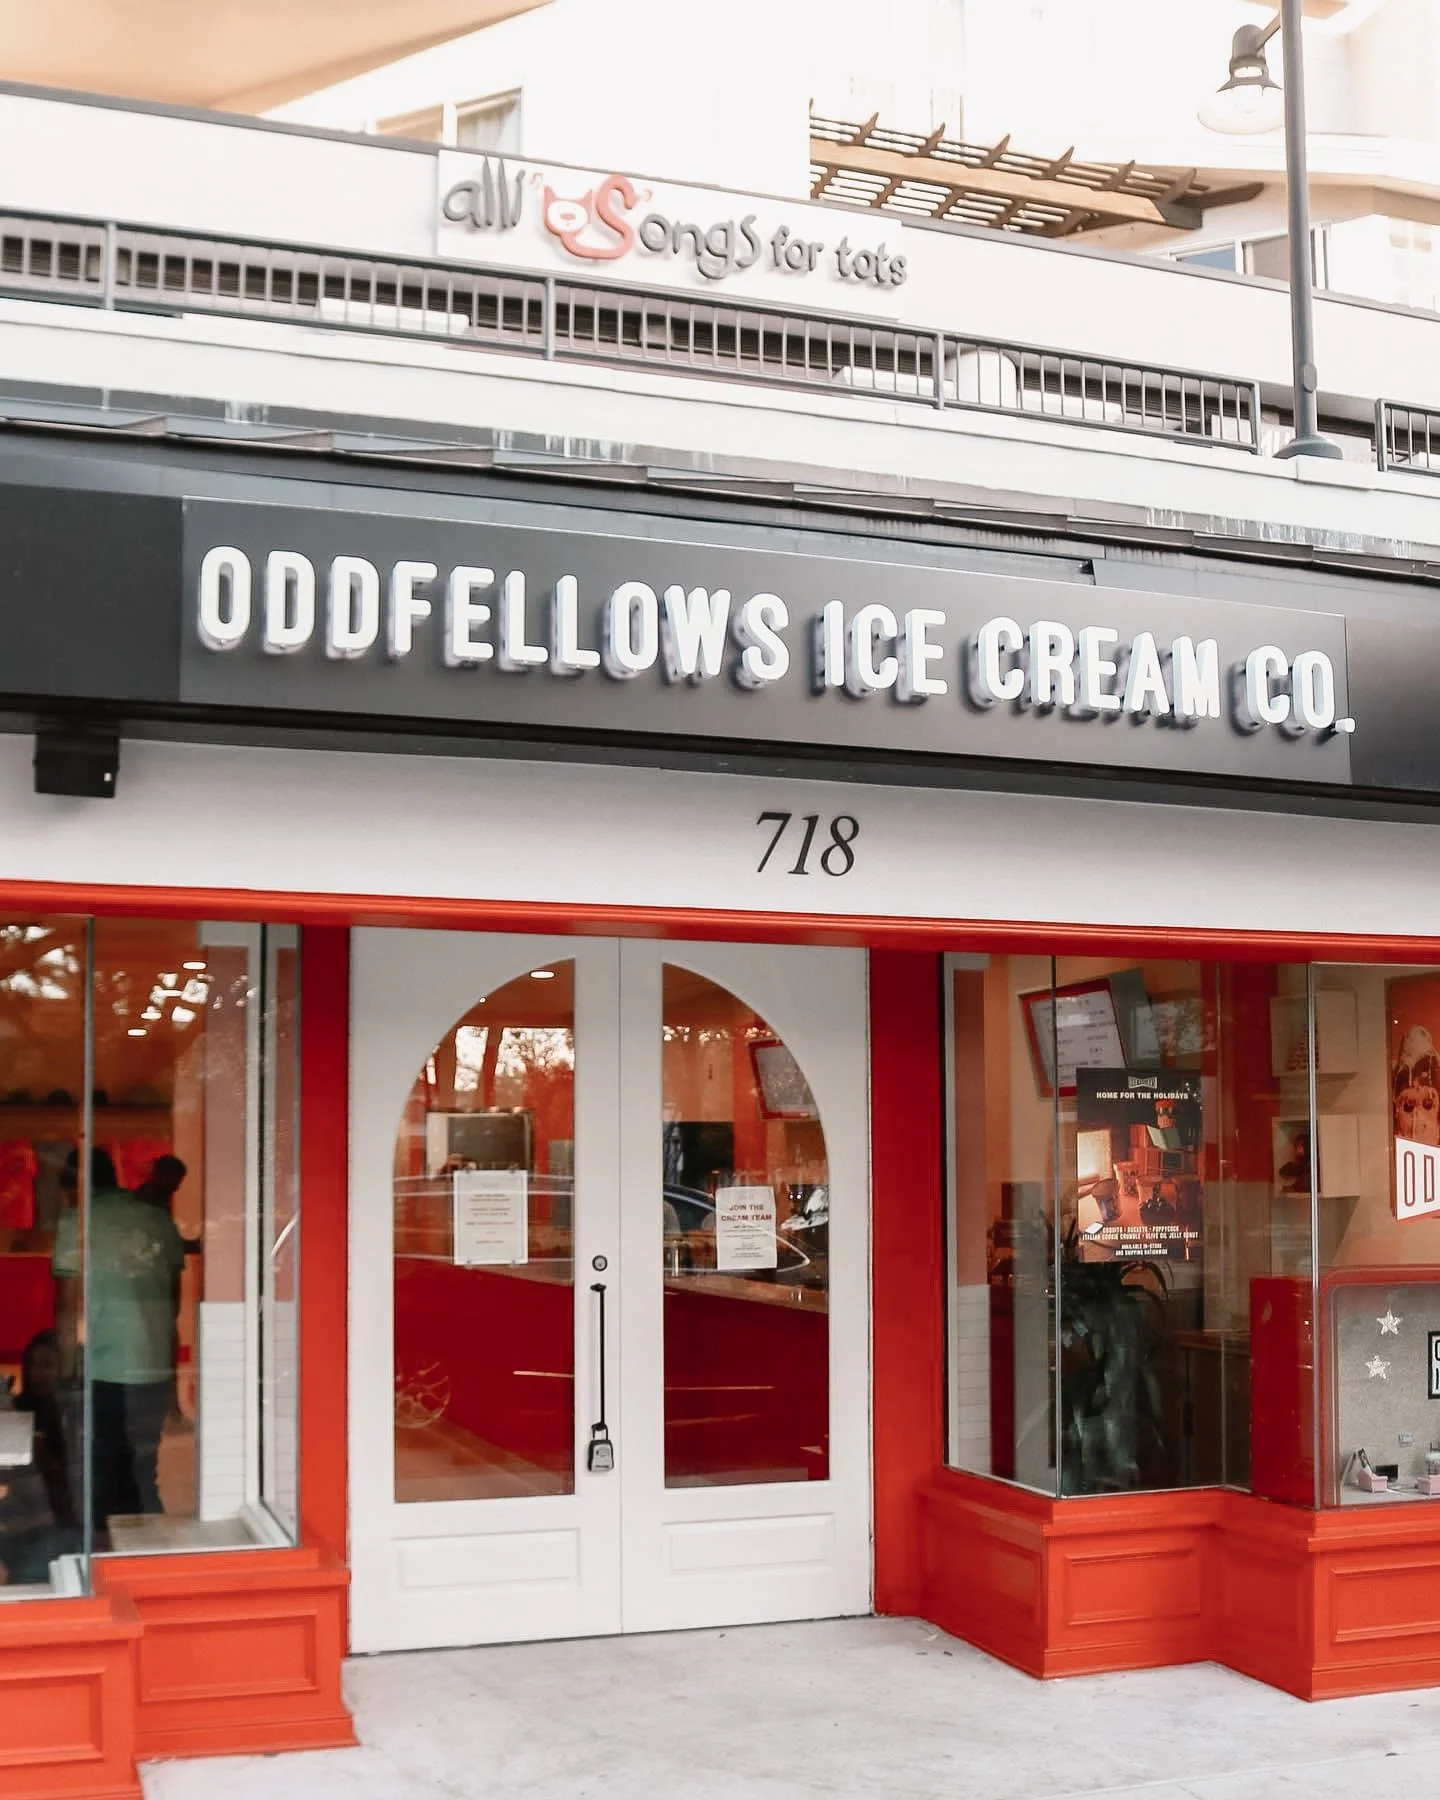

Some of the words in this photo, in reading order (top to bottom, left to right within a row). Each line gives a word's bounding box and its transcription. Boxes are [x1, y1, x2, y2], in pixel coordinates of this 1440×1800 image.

[770, 224, 825, 272] for
[834, 236, 908, 286] tots
[199, 545, 790, 682] ODDFELLOWS
[823, 600, 948, 696] ICE
[976, 616, 1222, 719] CREAM
[1245, 645, 1355, 733] CO.
[756, 811, 860, 877] 718
[1096, 1091, 1118, 1099] HOME
[1120, 1091, 1135, 1099] FOR
[1137, 1091, 1151, 1099] THE
[1153, 1091, 1188, 1099] HOLIDAYS
